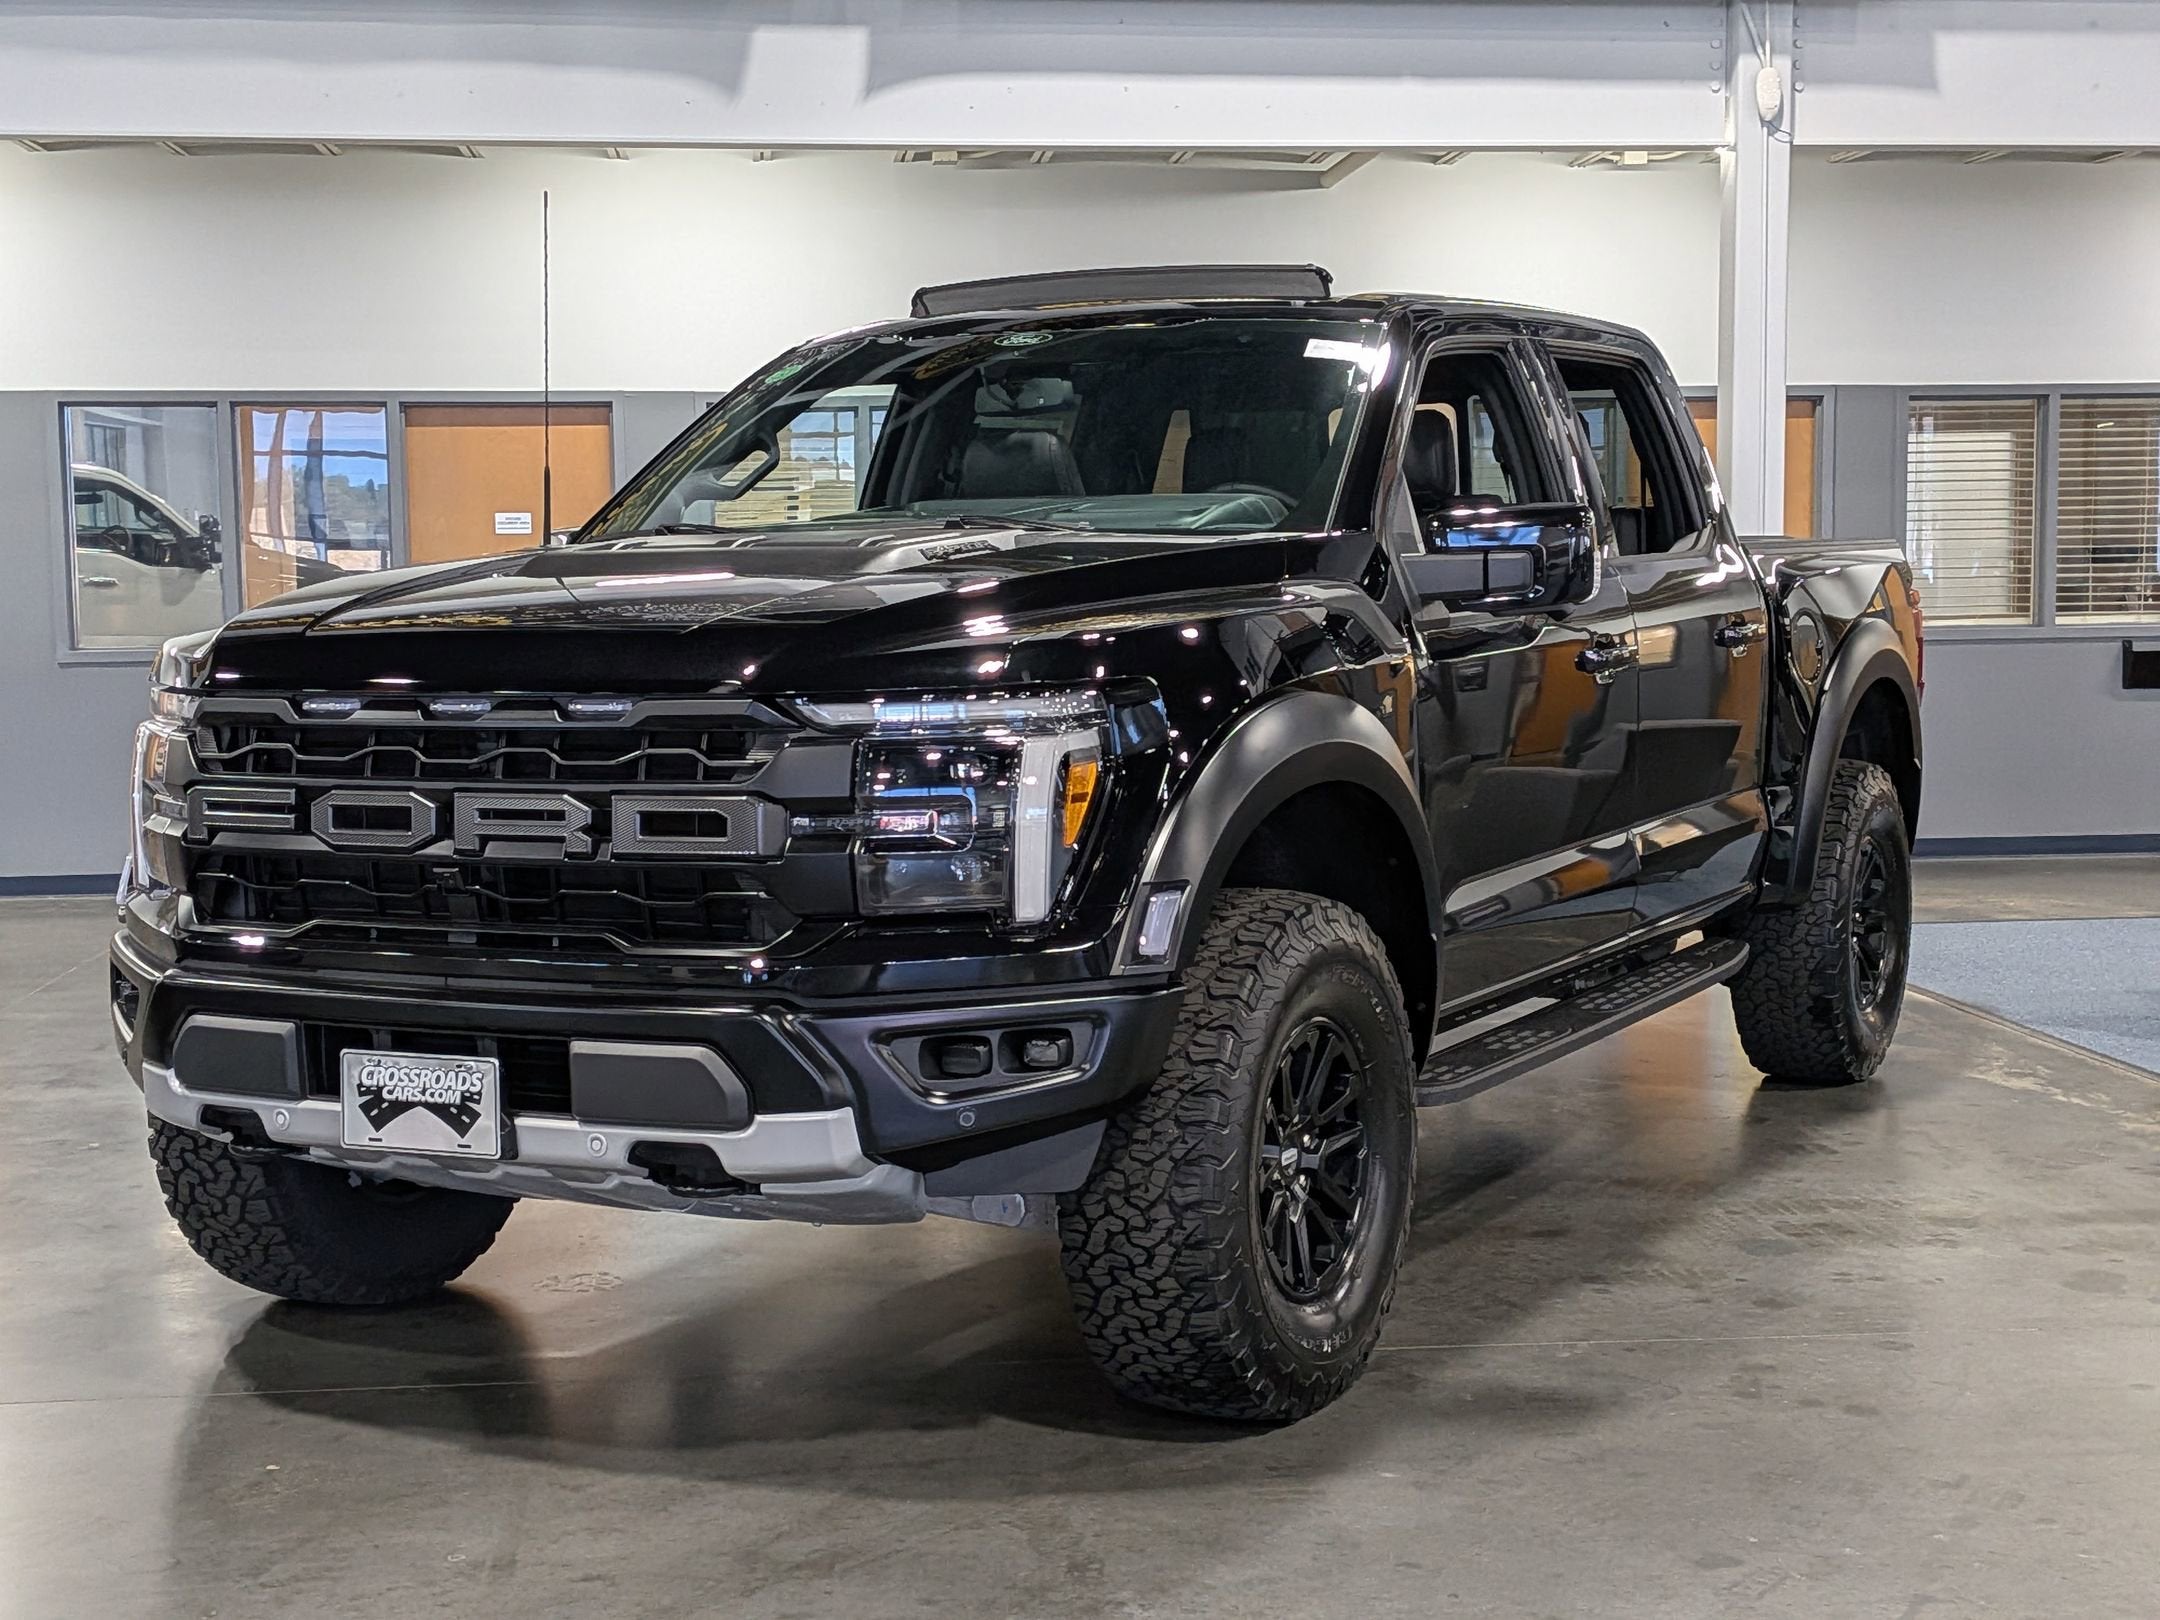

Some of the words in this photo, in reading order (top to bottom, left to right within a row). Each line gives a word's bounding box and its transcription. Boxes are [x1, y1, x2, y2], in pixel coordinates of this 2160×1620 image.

[923, 541, 994, 560] RAPTOR
[184, 785, 786, 862] FORD
[360, 1064, 484, 1093] CROSSROADS
[381, 1086, 462, 1106] CARS.COM
